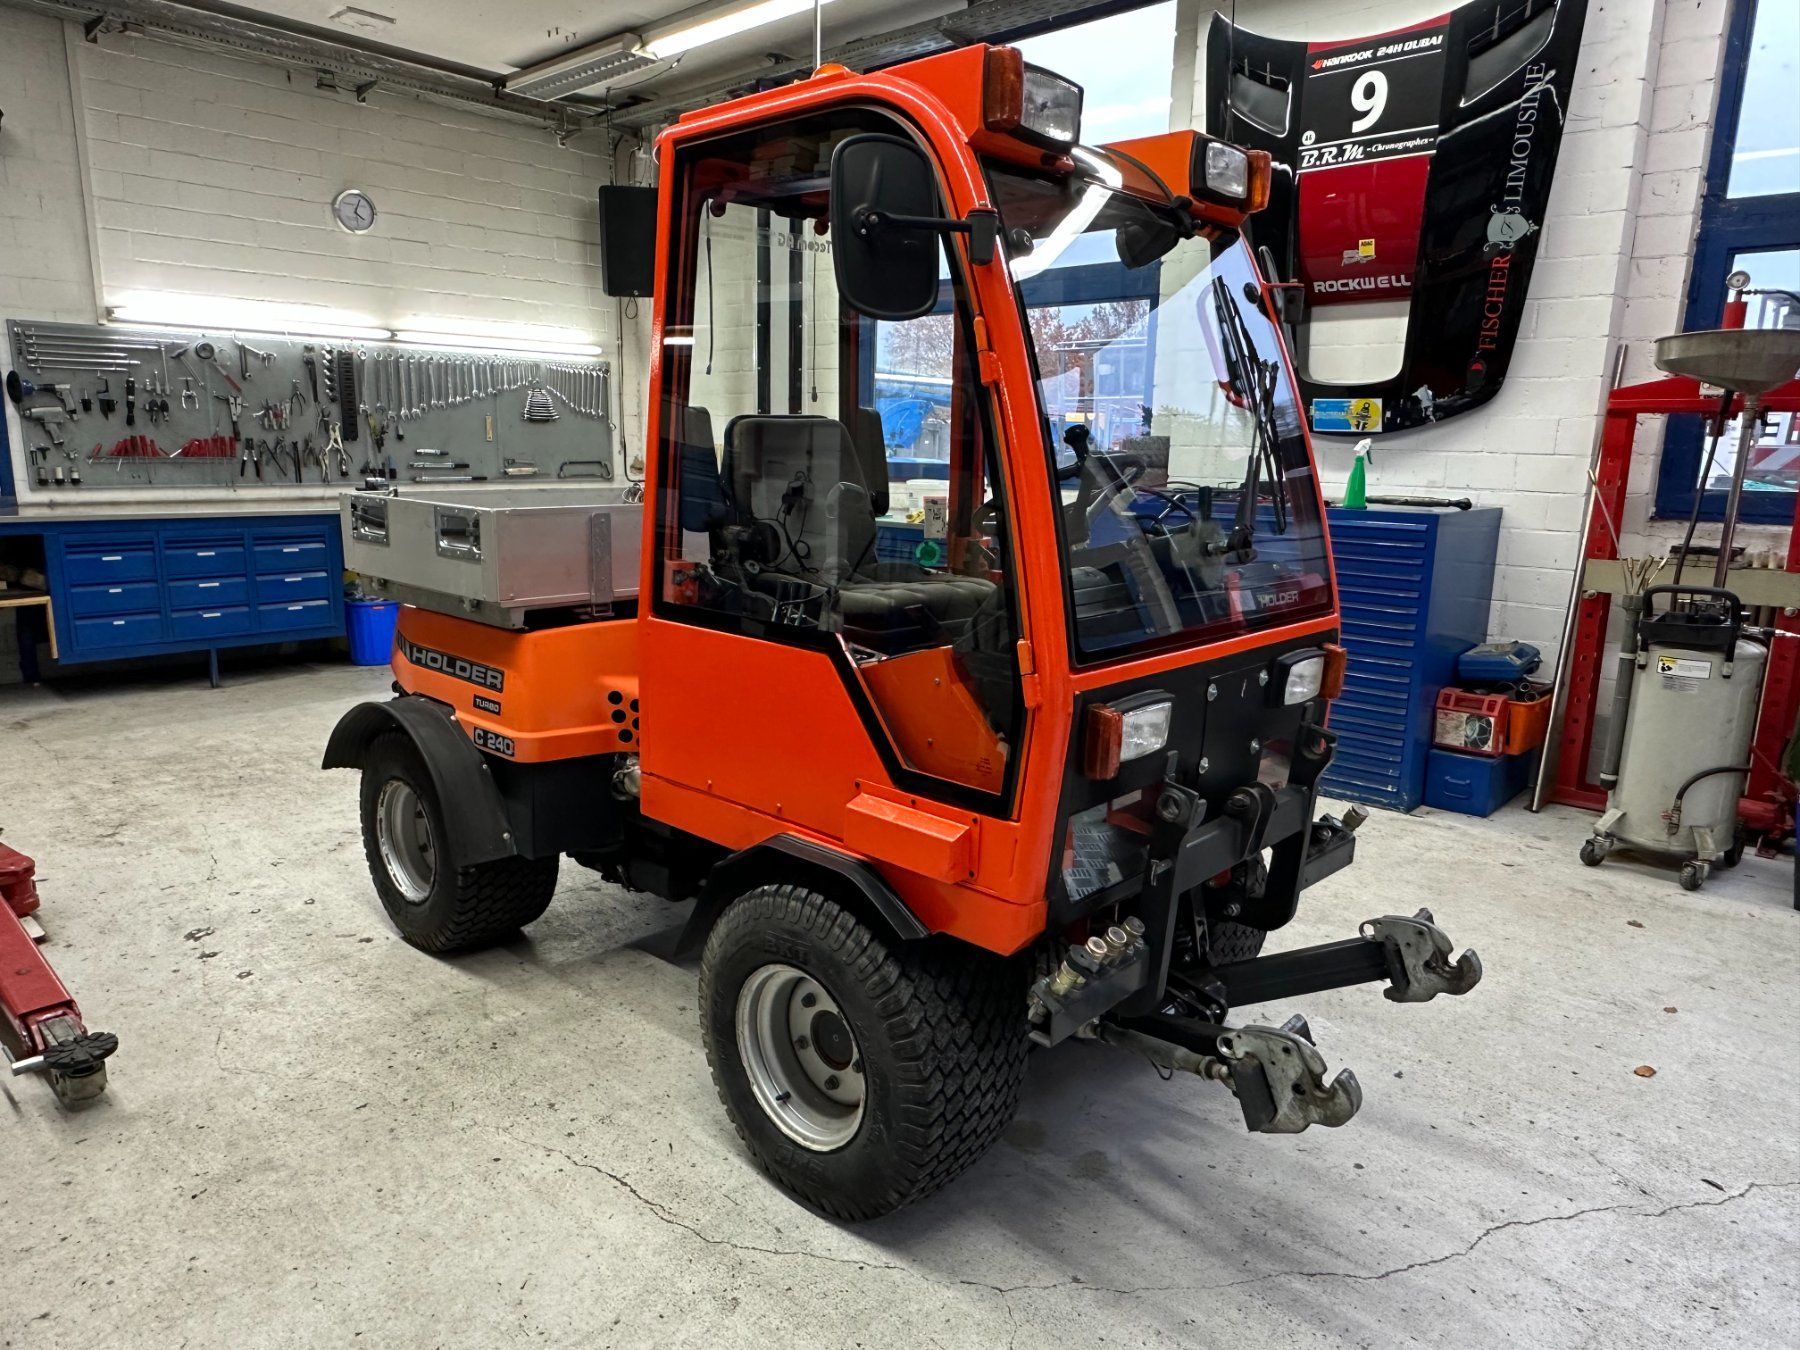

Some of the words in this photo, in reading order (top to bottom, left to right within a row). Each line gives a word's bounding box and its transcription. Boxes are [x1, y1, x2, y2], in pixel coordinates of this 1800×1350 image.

[1376, 44, 1402, 57] 24H
[1403, 34, 1444, 51] DUBAI
[1351, 70, 1389, 134] 9
[1504, 62, 1545, 201] LIMOUSINE
[1313, 274, 1412, 293] ROCKWELL
[1478, 253, 1512, 351] FISCHER
[411, 646, 503, 689] HOLDER
[475, 698, 500, 713] TURBO
[474, 729, 484, 745] C
[487, 733, 515, 756] 240
